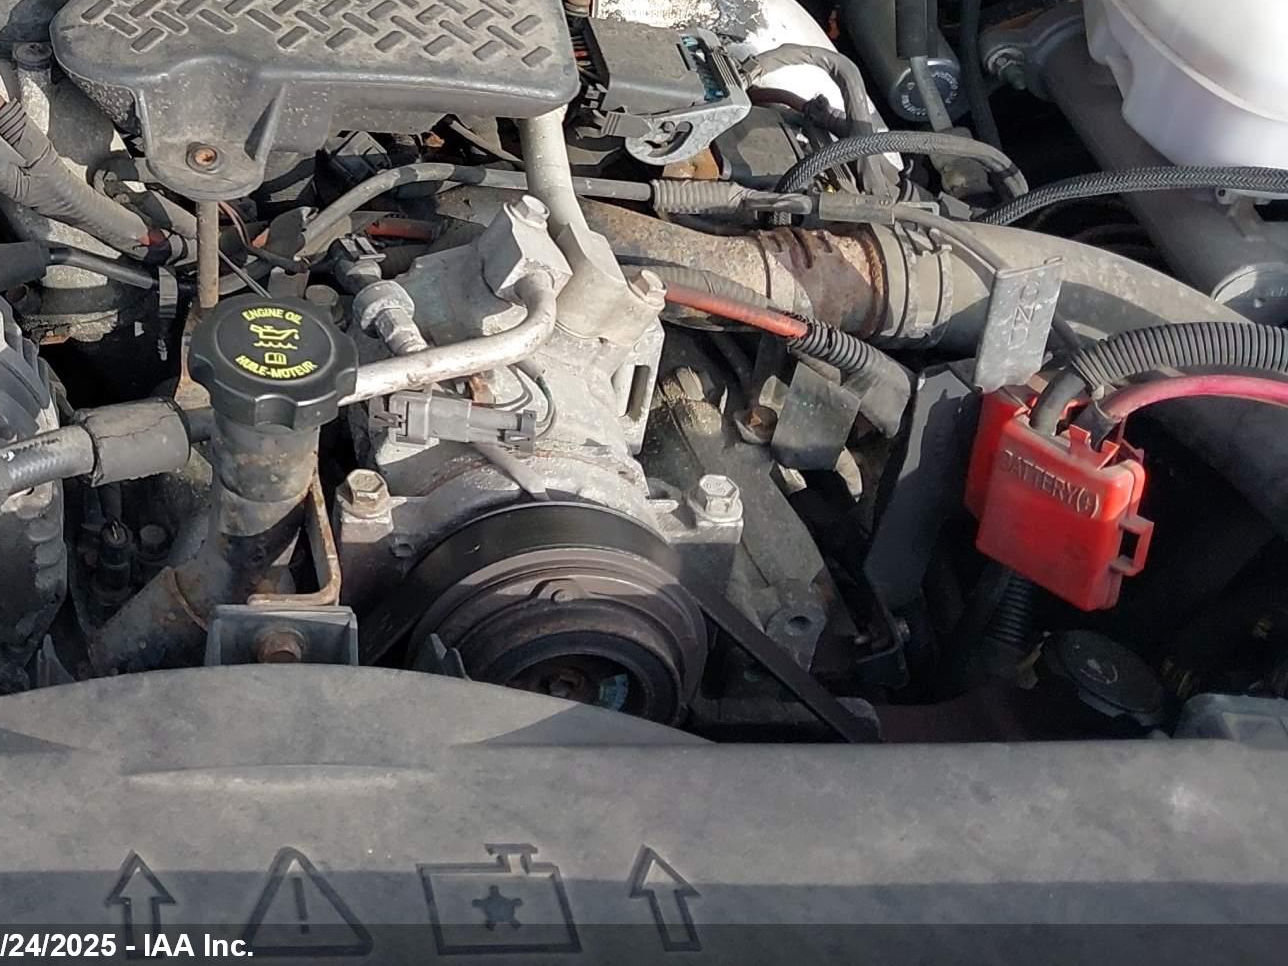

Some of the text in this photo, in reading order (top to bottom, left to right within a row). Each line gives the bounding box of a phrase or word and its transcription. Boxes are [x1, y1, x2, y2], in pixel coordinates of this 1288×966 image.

[242, 307, 303, 325] ENGINE OIL
[235, 355, 318, 378] HUILE-MOTEUR
